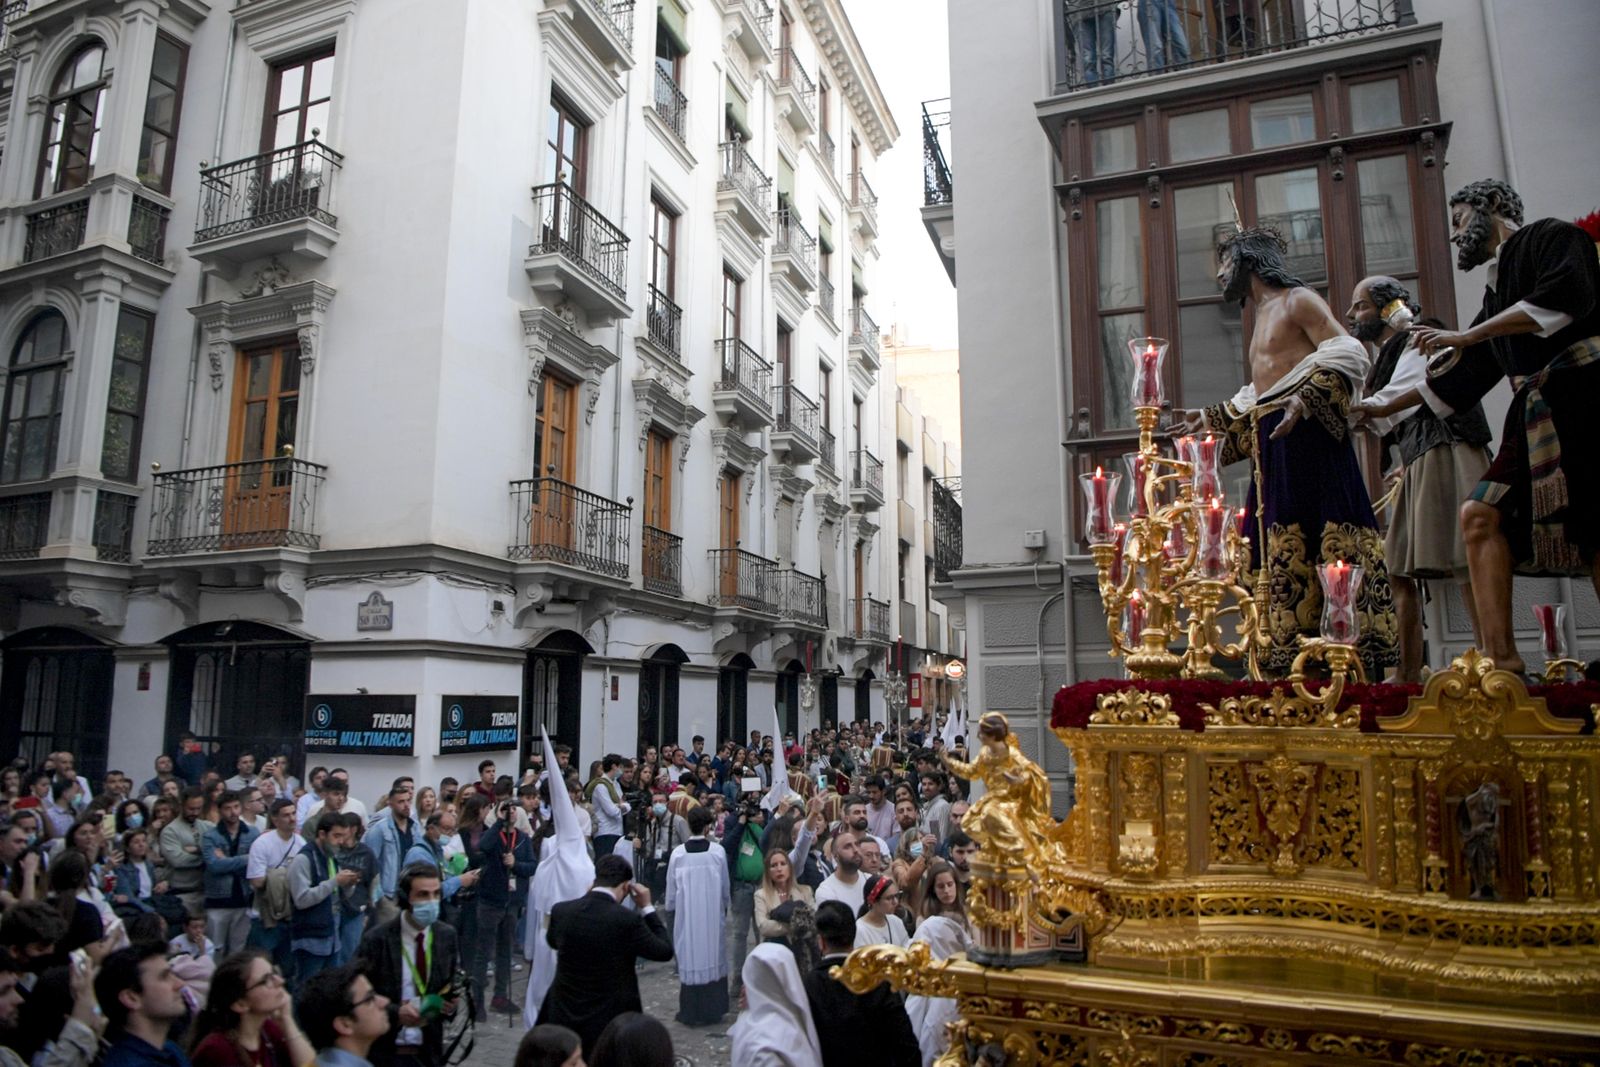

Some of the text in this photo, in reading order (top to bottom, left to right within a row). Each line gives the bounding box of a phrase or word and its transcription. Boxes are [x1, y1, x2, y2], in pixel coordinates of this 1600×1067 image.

[372, 713, 413, 729] TIENDA
[491, 712, 517, 726] TIENDA
[338, 731, 412, 747] MULTIMARCA
[442, 730, 467, 738] BROTHER
[468, 728, 517, 745] MULTIMARCA
[304, 738, 337, 746] BROTHER
[441, 738, 467, 747] BROTHER
